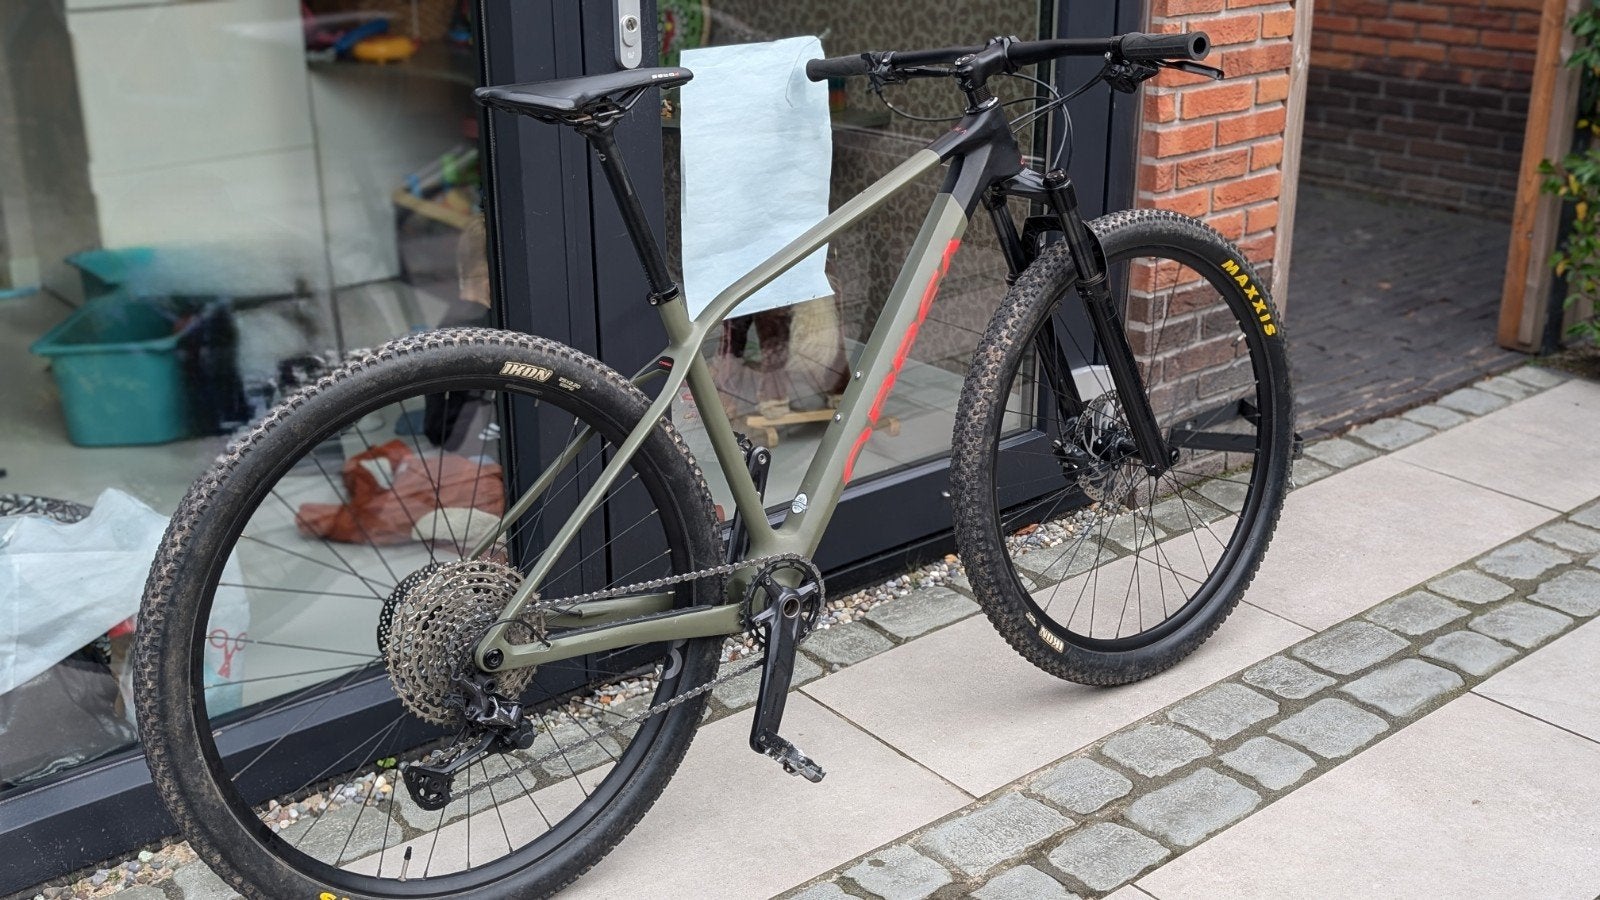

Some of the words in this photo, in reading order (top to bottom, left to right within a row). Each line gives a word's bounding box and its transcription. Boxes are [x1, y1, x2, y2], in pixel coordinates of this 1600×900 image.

[1221, 259, 1276, 336] MAXXIS
[500, 362, 553, 382] IKON
[1039, 625, 1064, 653] IKON
